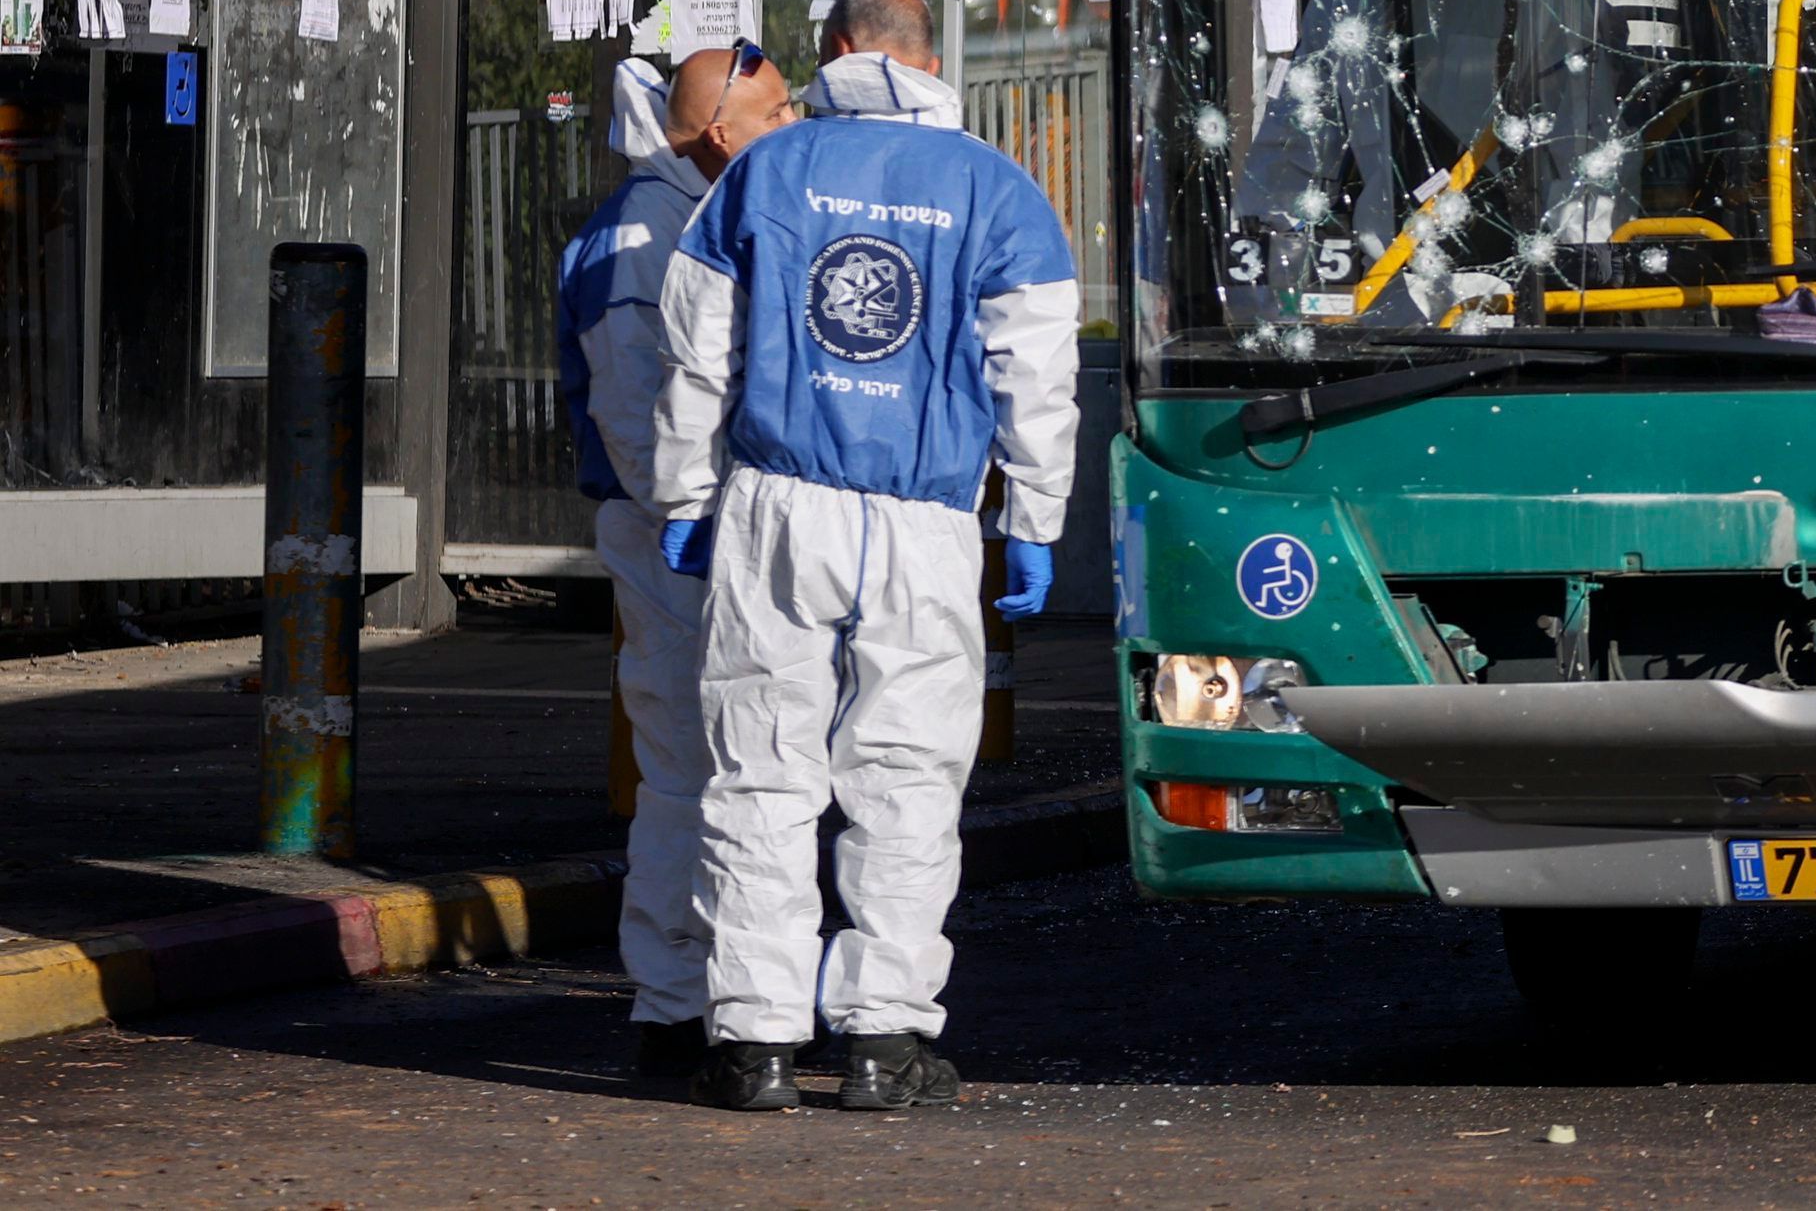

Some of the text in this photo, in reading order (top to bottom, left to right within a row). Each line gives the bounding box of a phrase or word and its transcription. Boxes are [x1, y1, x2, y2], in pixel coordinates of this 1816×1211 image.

[868, 203, 952, 228] משטרת
[1228, 238, 1352, 283] 3 5
[858, 380, 902, 398] זיהוי
[1739, 860, 1760, 882] IL
